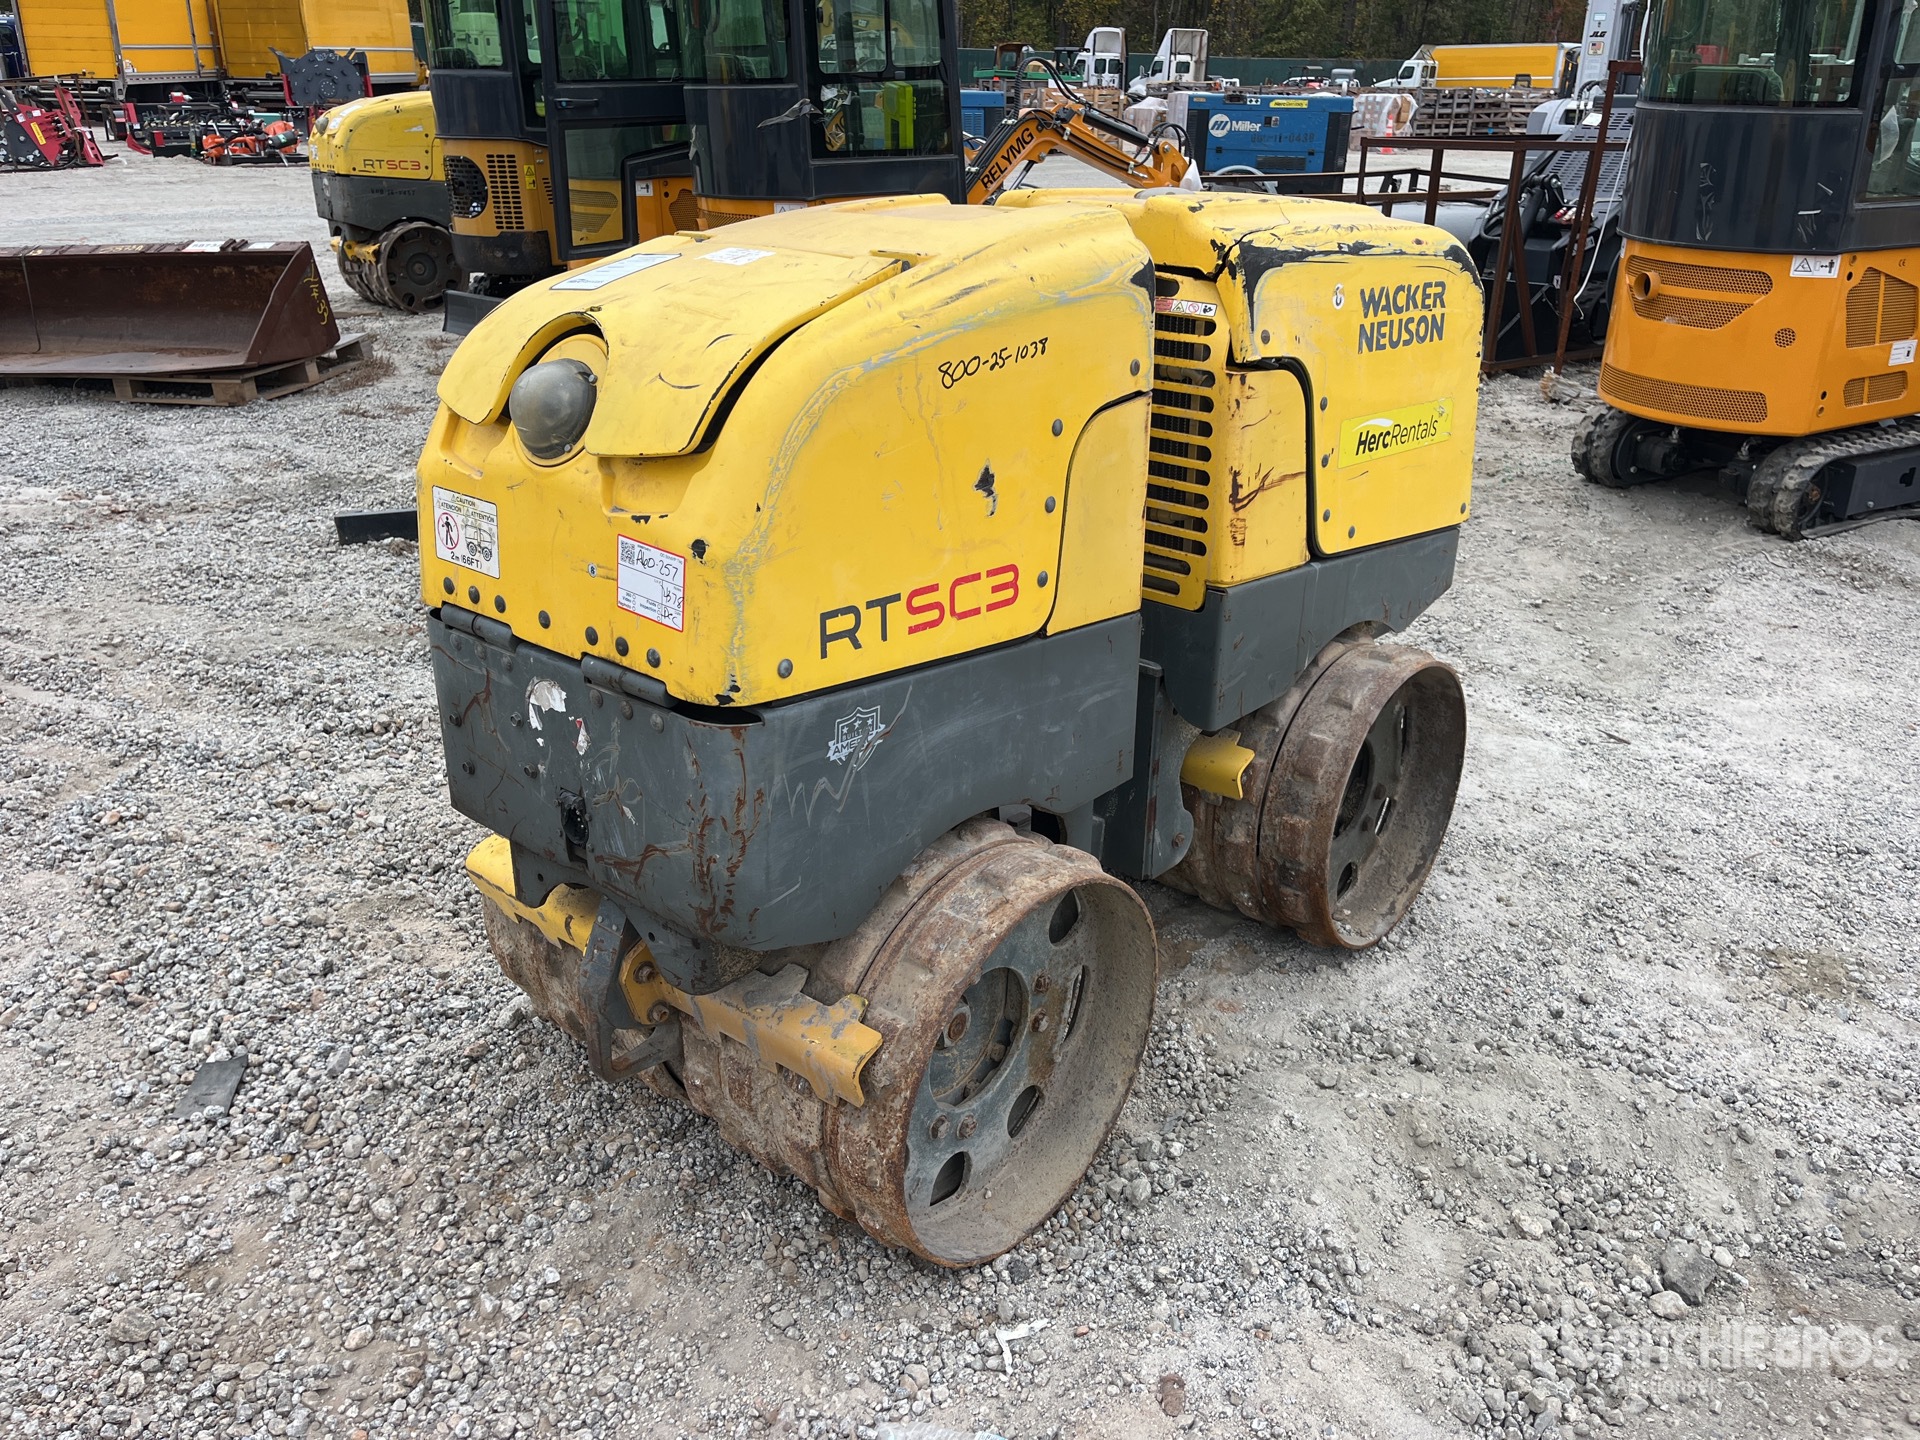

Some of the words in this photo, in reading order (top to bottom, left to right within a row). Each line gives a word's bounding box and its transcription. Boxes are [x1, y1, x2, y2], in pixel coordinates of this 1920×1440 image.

[1231, 120, 1262, 132] Miller
[363, 159, 421, 171] RTSC3
[980, 127, 1035, 189] RELYMG
[1359, 280, 1447, 319] WACKER
[1357, 312, 1446, 355] NEUSON
[938, 336, 1048, 389] 800-25-1038
[1355, 414, 1439, 456] HercRentals
[456, 496, 476, 507] CAUTION
[819, 563, 1019, 660] RTSC3
